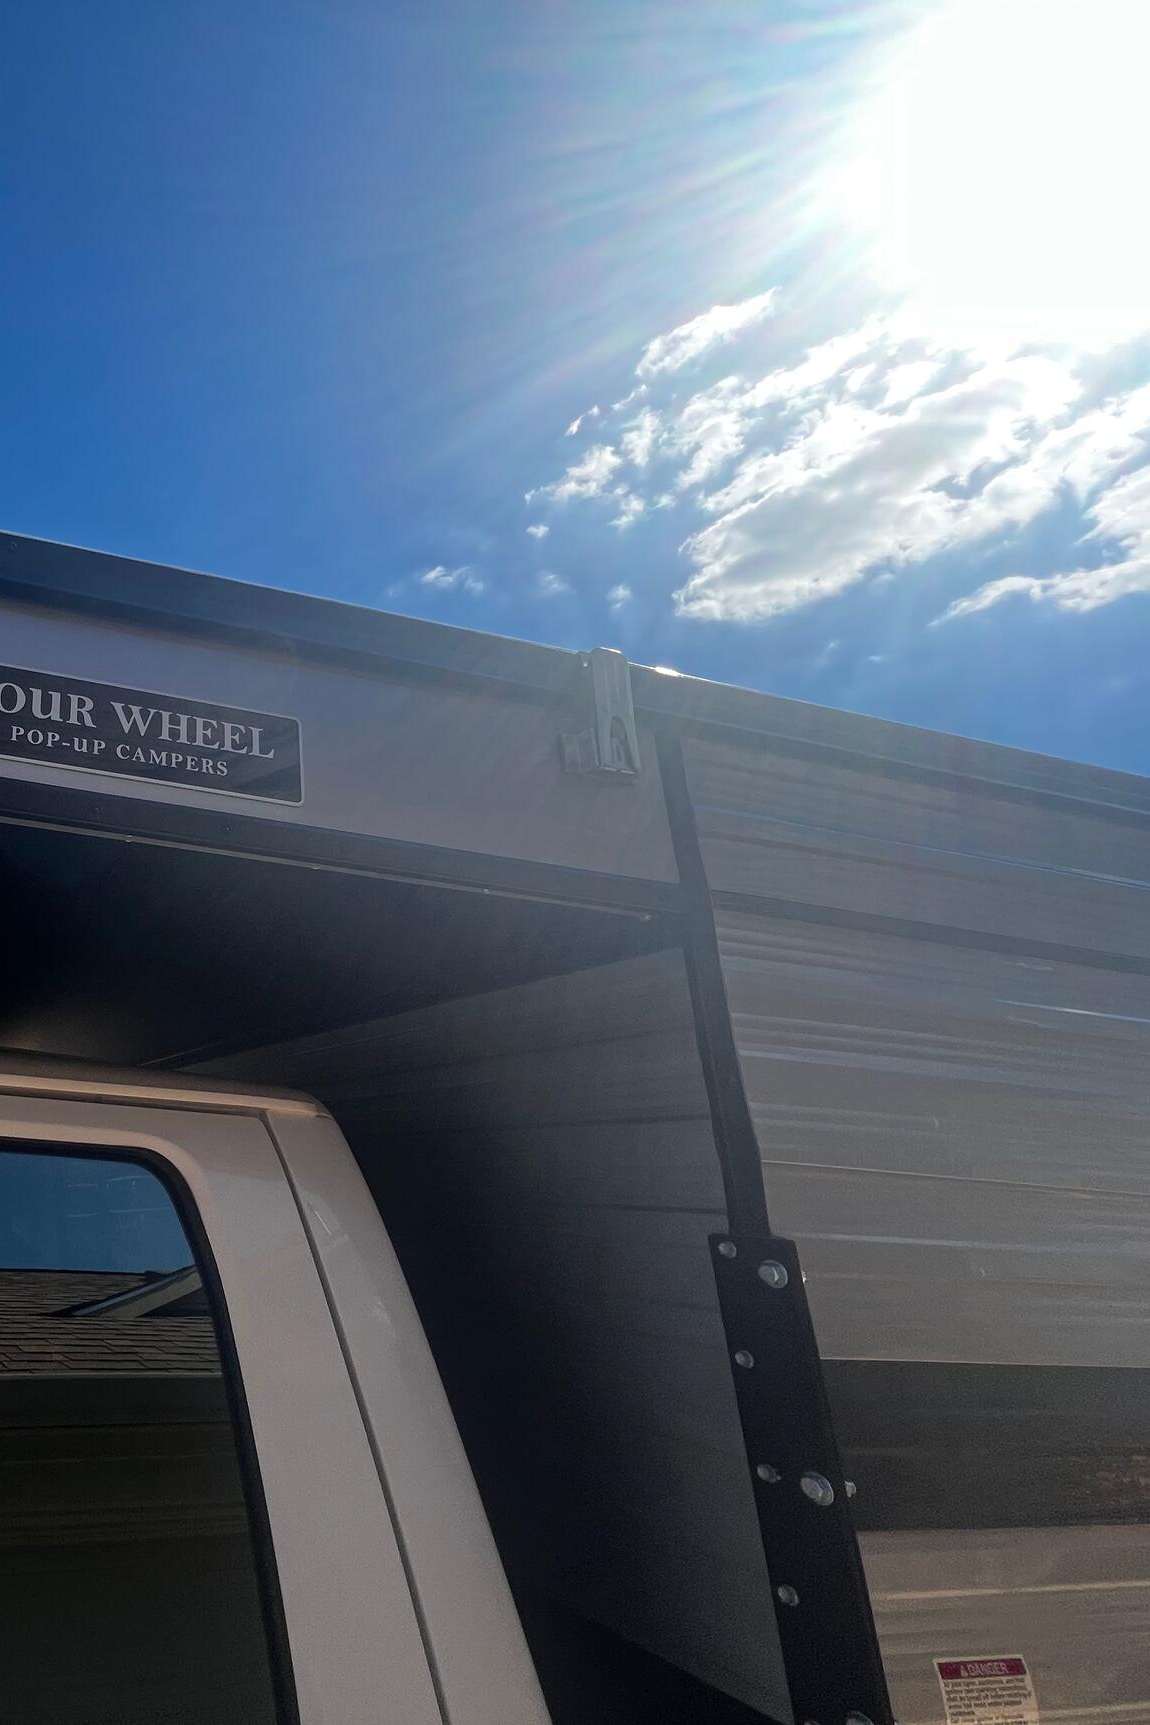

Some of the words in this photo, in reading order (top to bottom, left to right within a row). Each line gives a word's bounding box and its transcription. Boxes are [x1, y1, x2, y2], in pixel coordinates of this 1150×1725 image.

[10, 725, 107, 756] POP-UP
[116, 743, 229, 776] CAMPERS
[110, 701, 275, 759] WHEEL
[967, 1661, 1010, 1676] DANGER
